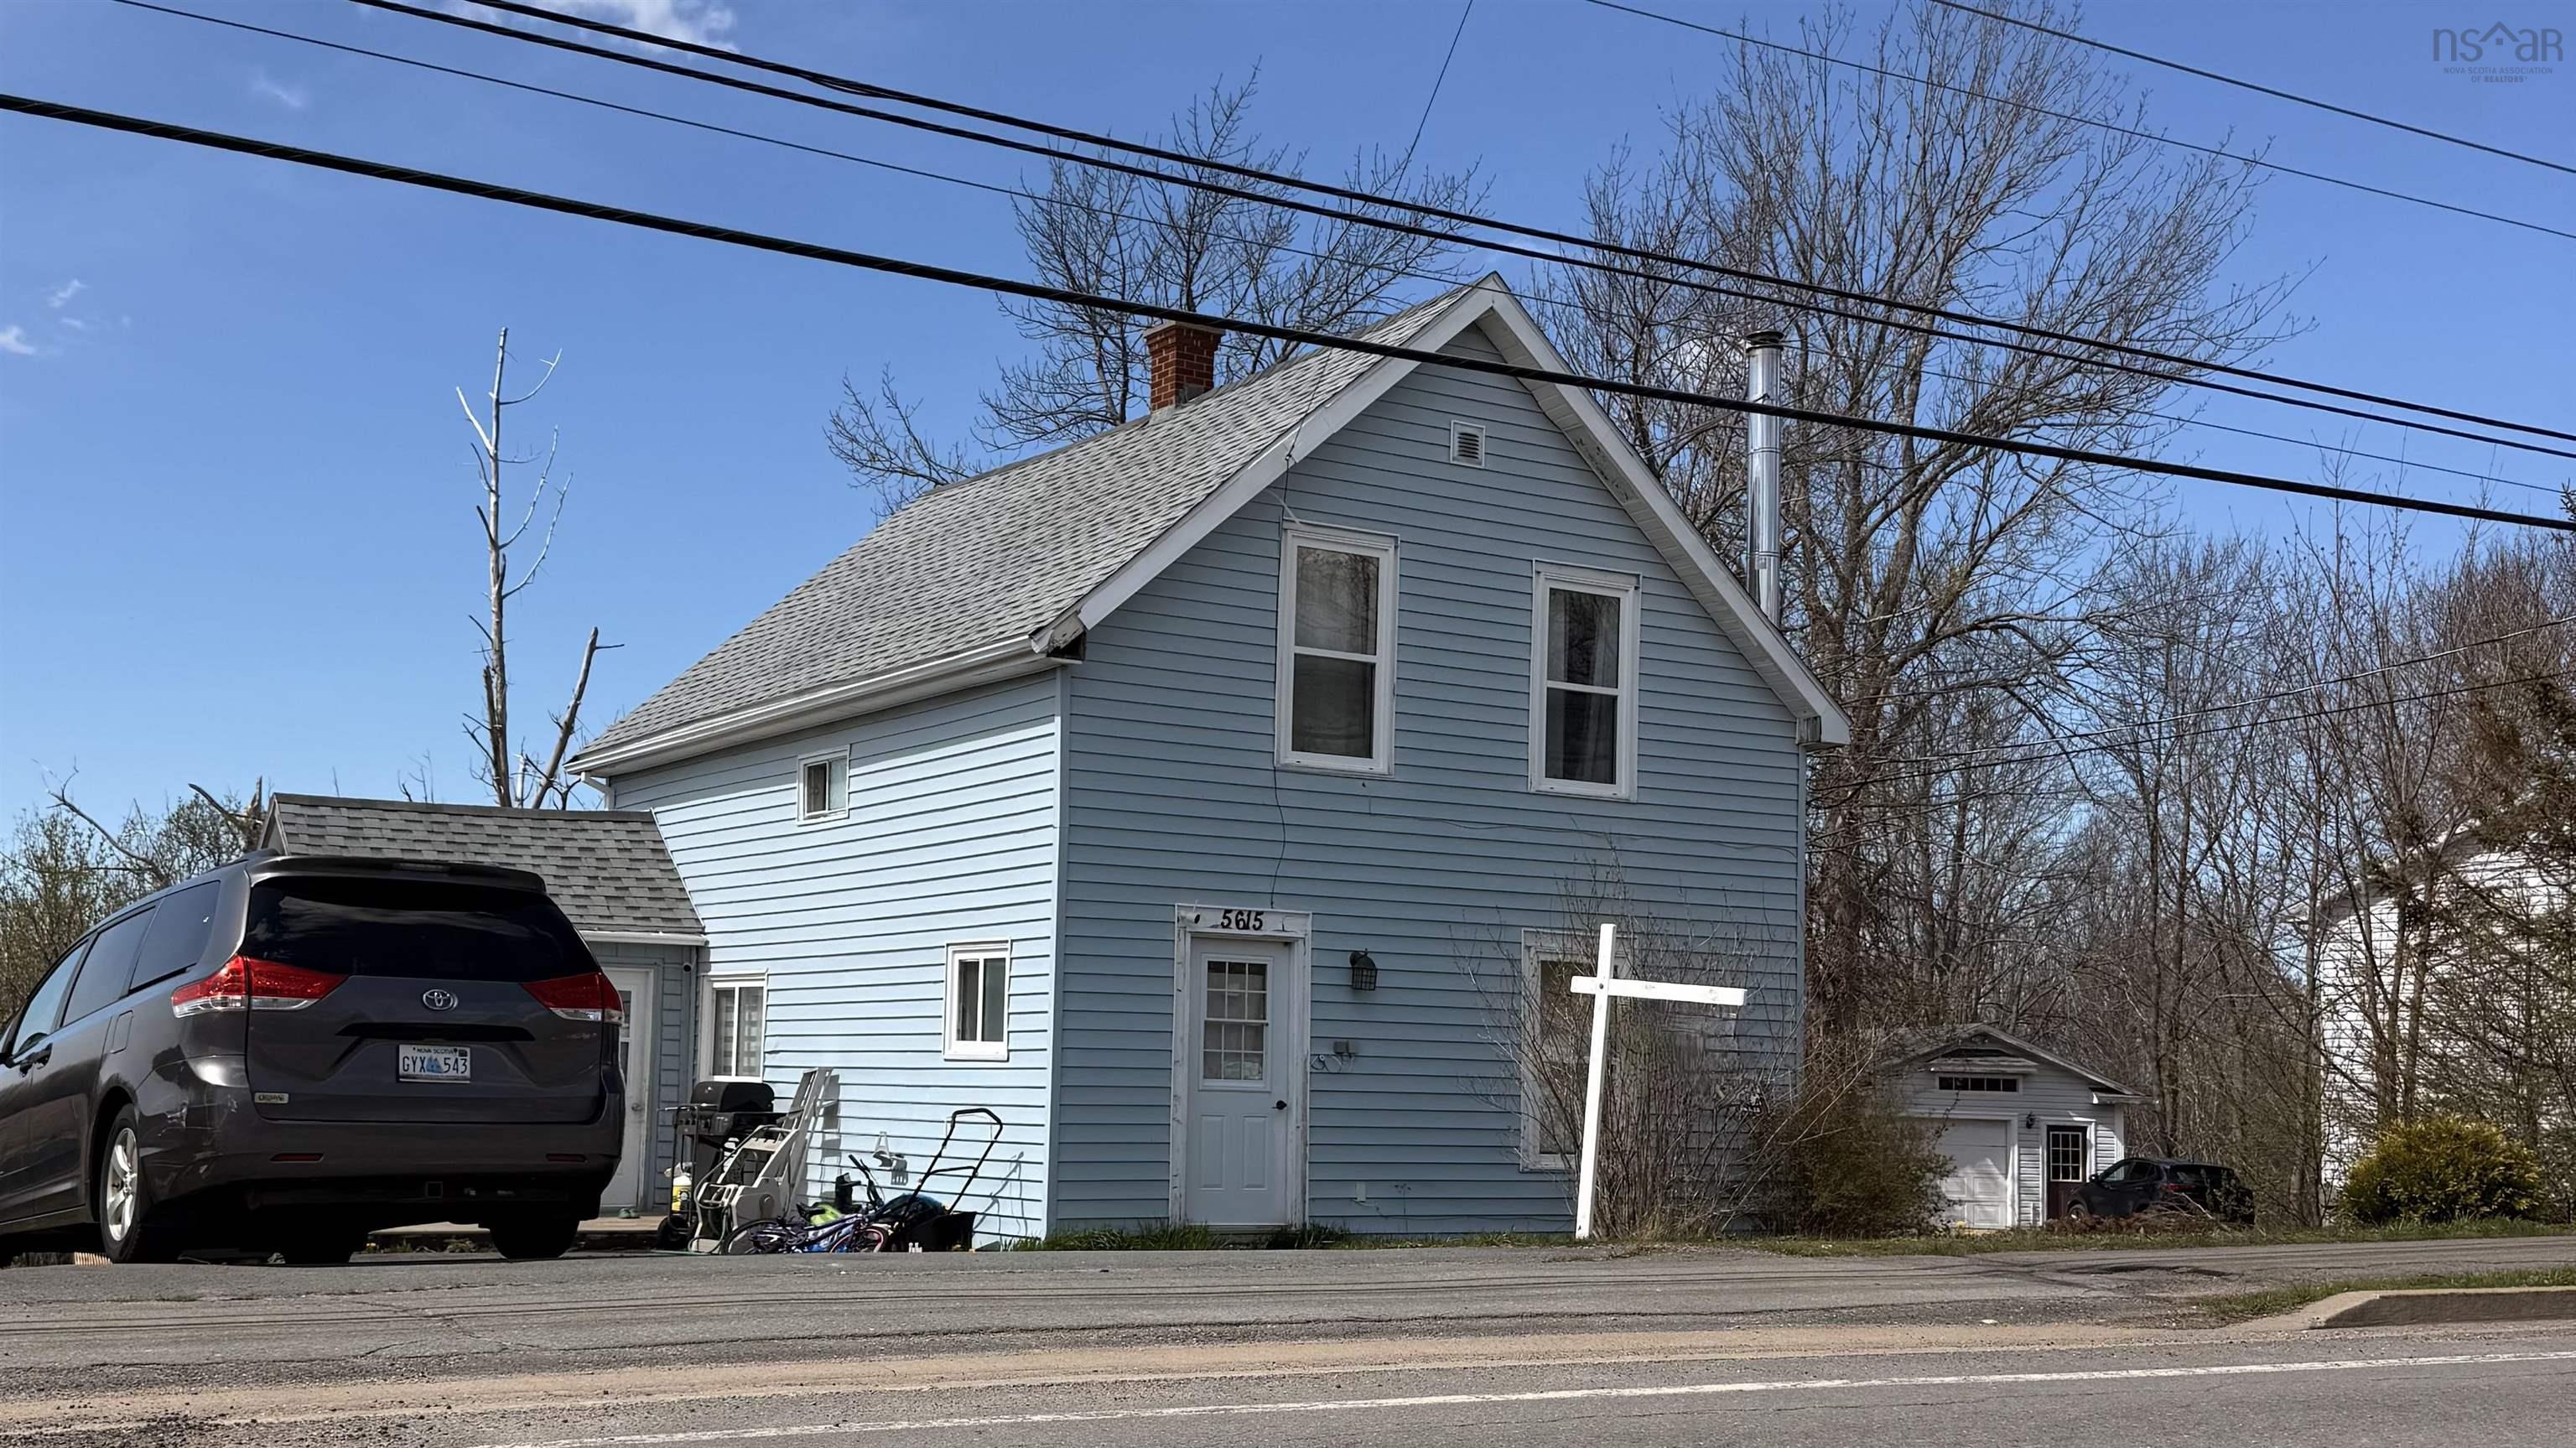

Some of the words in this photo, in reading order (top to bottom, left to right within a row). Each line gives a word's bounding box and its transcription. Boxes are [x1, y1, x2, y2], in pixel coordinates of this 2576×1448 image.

[1220, 909, 1265, 931] 5615
[402, 1056, 426, 1073] GYX
[443, 1057, 468, 1074] 543
